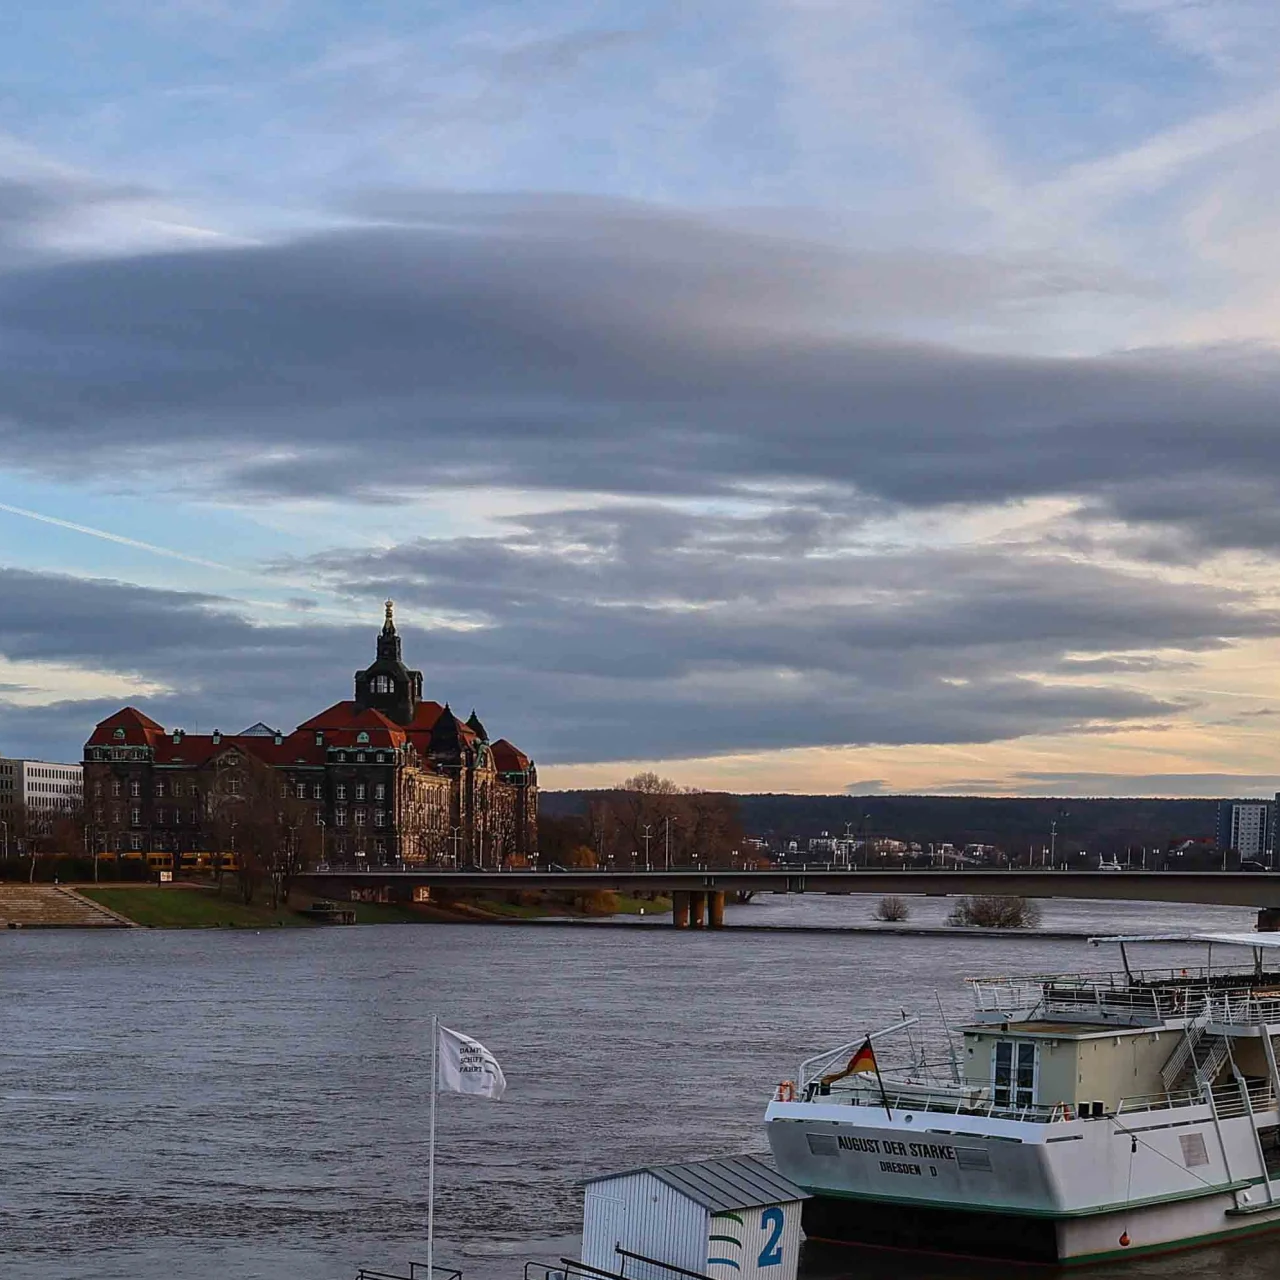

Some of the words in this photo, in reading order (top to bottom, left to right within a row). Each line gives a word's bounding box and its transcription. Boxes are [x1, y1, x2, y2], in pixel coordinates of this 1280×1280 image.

[837, 1135, 880, 1154] AUGUST
[881, 1140, 908, 1156] DER
[910, 1142, 956, 1160] STARKE
[879, 1160, 922, 1176] DRESDEN
[929, 1166, 938, 1177] D
[757, 1207, 785, 1269] 2
